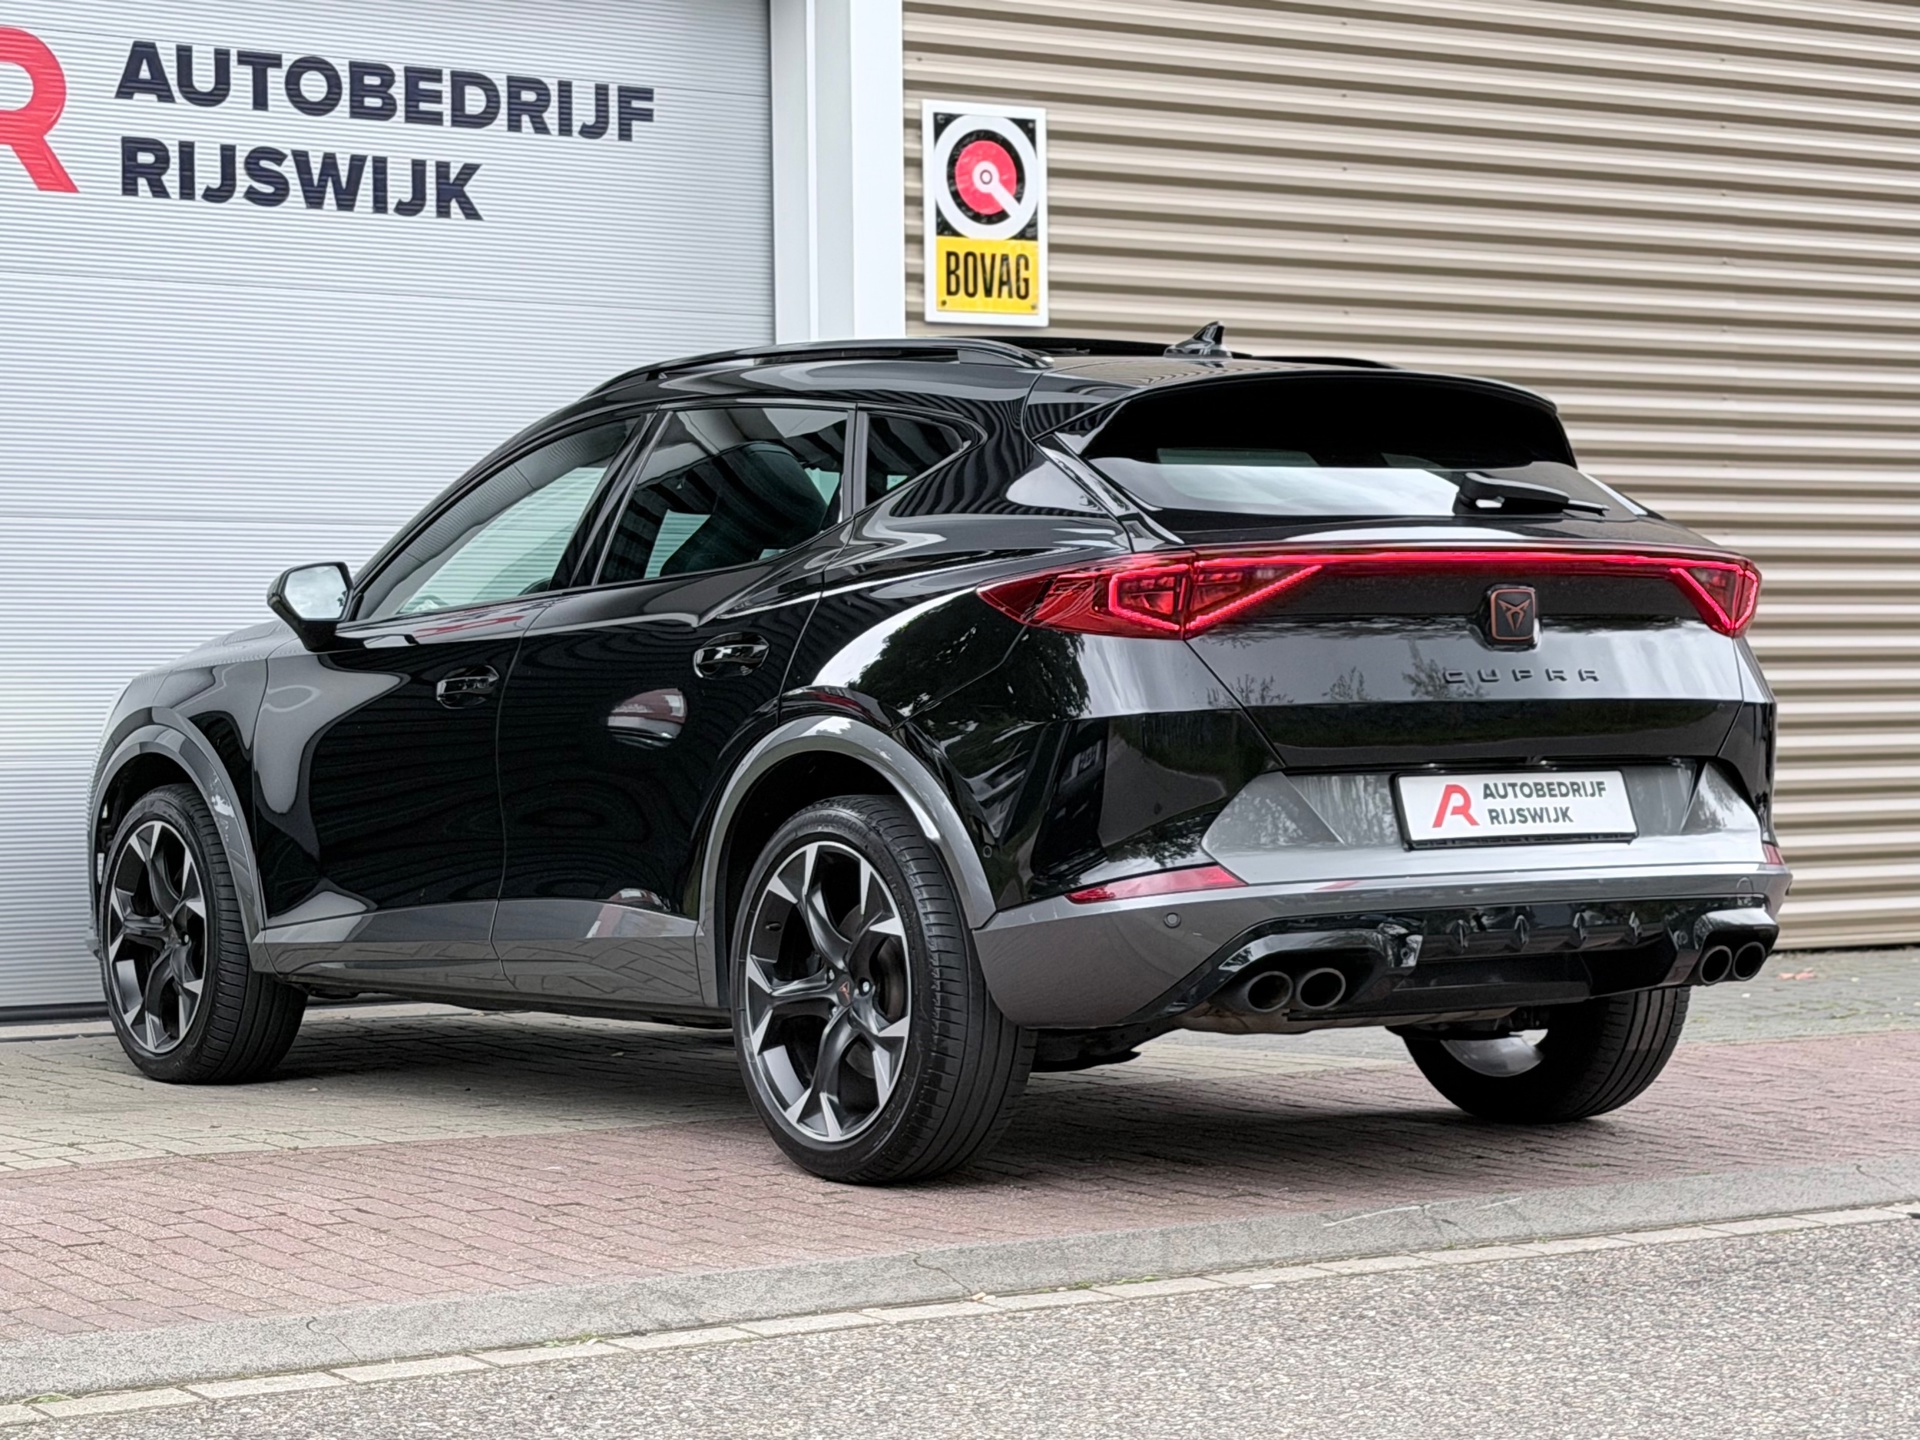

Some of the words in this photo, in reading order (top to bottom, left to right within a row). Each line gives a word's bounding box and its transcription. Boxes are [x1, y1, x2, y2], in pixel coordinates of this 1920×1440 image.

[115, 40, 654, 142] AUTOBEDRIJF
[121, 136, 484, 221] RIJSWIJK
[945, 251, 1030, 300] BOVAG
[1443, 668, 1599, 684] CUPRA
[1483, 781, 1606, 800] AUTOBEDRIJF
[1487, 806, 1574, 825] RIJSWIJK
